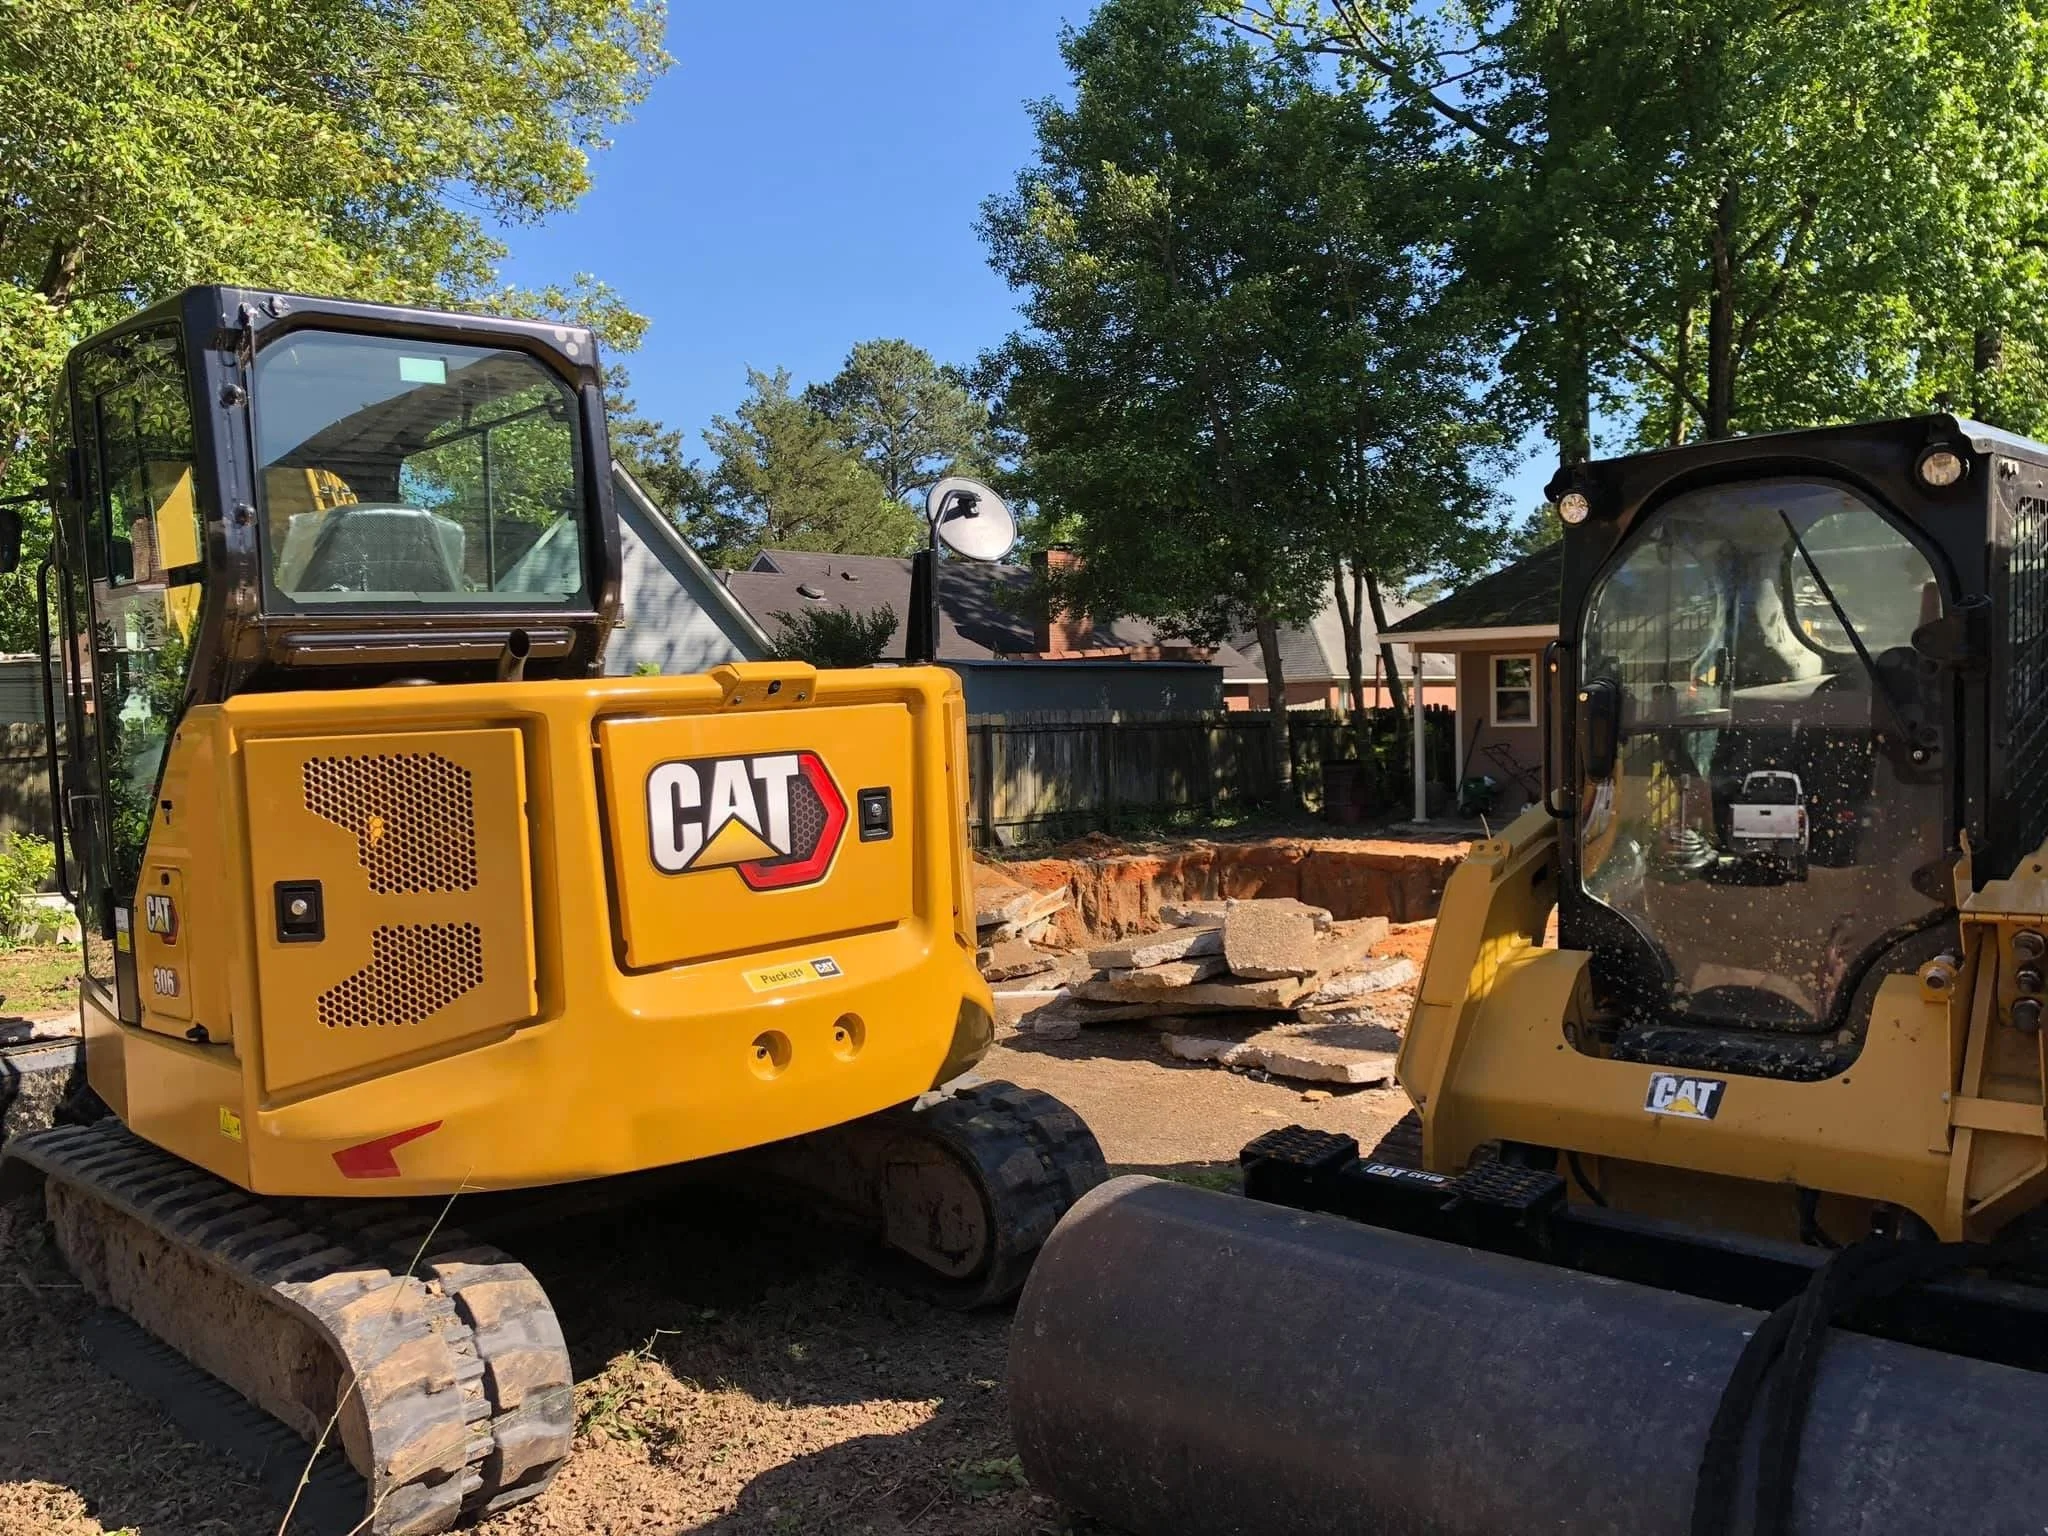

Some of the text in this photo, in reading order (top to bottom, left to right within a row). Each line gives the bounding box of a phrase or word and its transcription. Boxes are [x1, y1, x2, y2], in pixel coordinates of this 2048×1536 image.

[649, 754, 799, 870] CAT
[146, 895, 170, 933] CAT
[153, 967, 175, 995] 306
[814, 961, 835, 973] CAT
[1653, 1077, 1718, 1115] CAT
[1366, 1165, 1408, 1178] CAT
